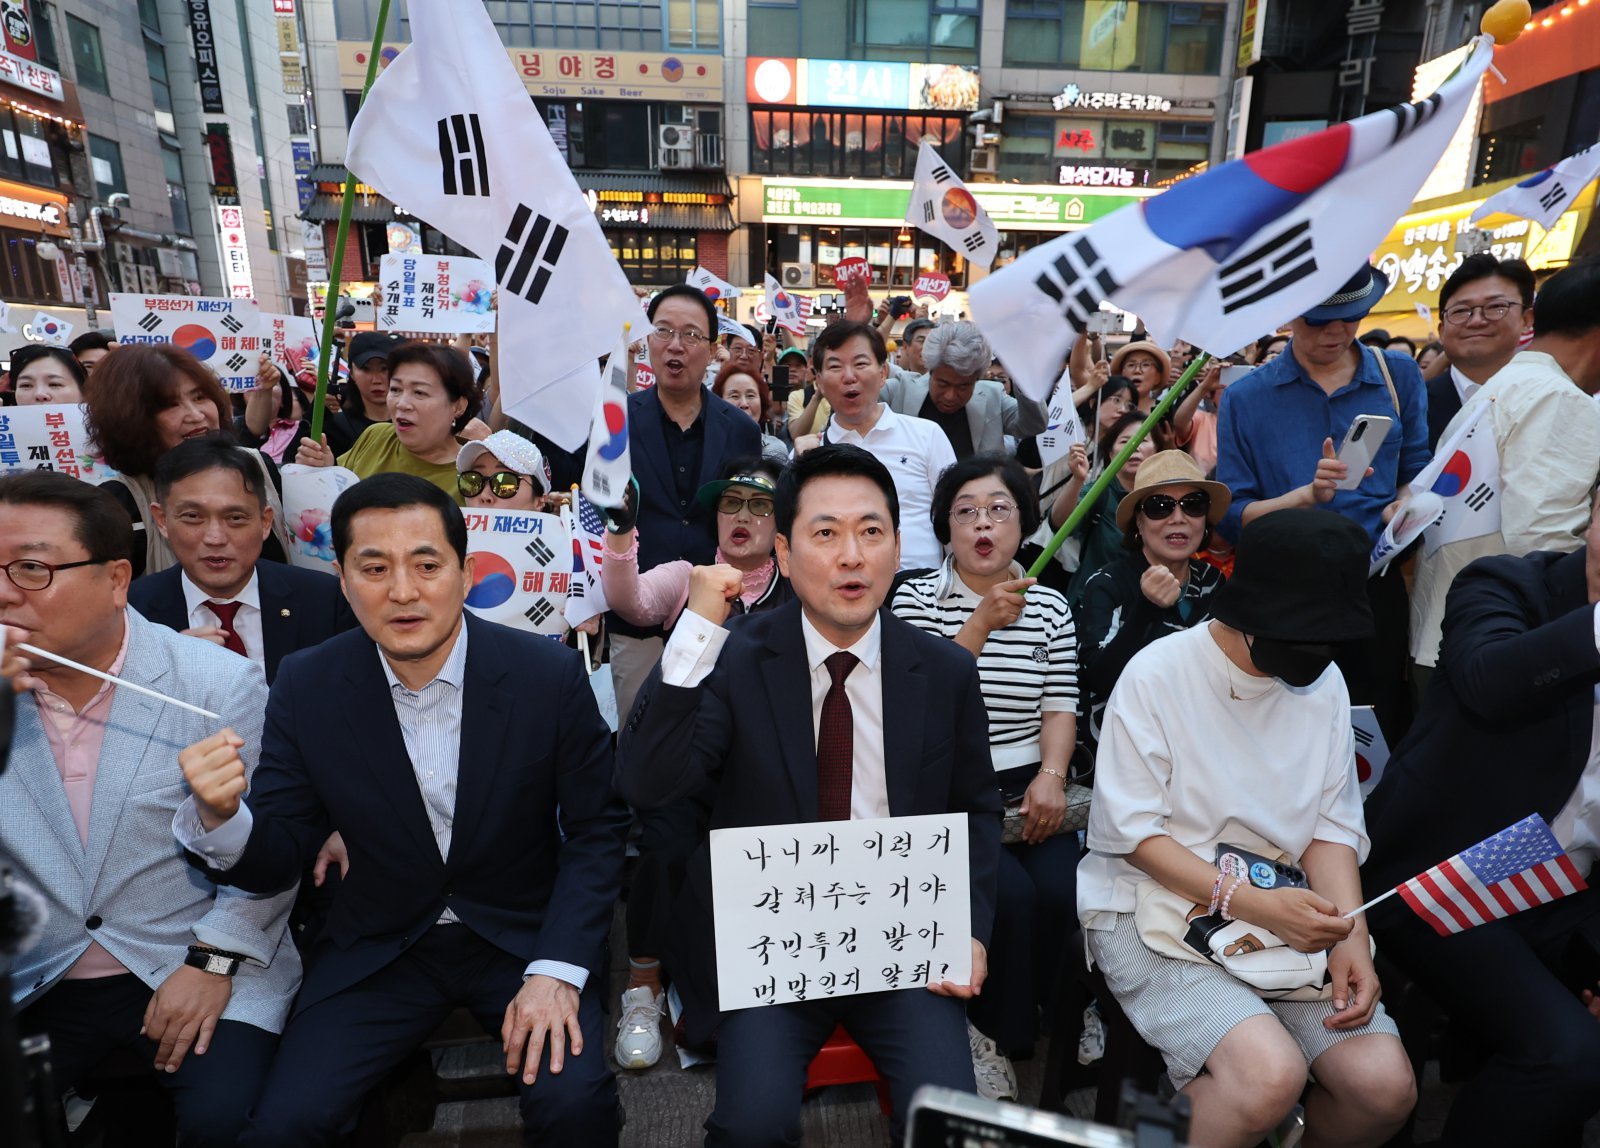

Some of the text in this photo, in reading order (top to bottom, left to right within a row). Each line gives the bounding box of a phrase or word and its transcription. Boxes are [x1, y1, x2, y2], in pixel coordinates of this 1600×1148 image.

[542, 86, 643, 98] Soju Sake Beer
[386, 280, 400, 315] 수개표
[403, 259, 416, 307] 당일투표
[421, 282, 434, 318] 재선거
[437, 261, 449, 310] 부정선거
[915, 277, 950, 294] 재선거
[144, 299, 232, 313] 부정선거 재선거
[273, 319, 287, 363] 부정선거
[45, 412, 80, 478] 부정선거
[493, 515, 543, 534] 재선거
[743, 826, 951, 872] 나니까 이런 거
[747, 926, 857, 966] 국민특검
